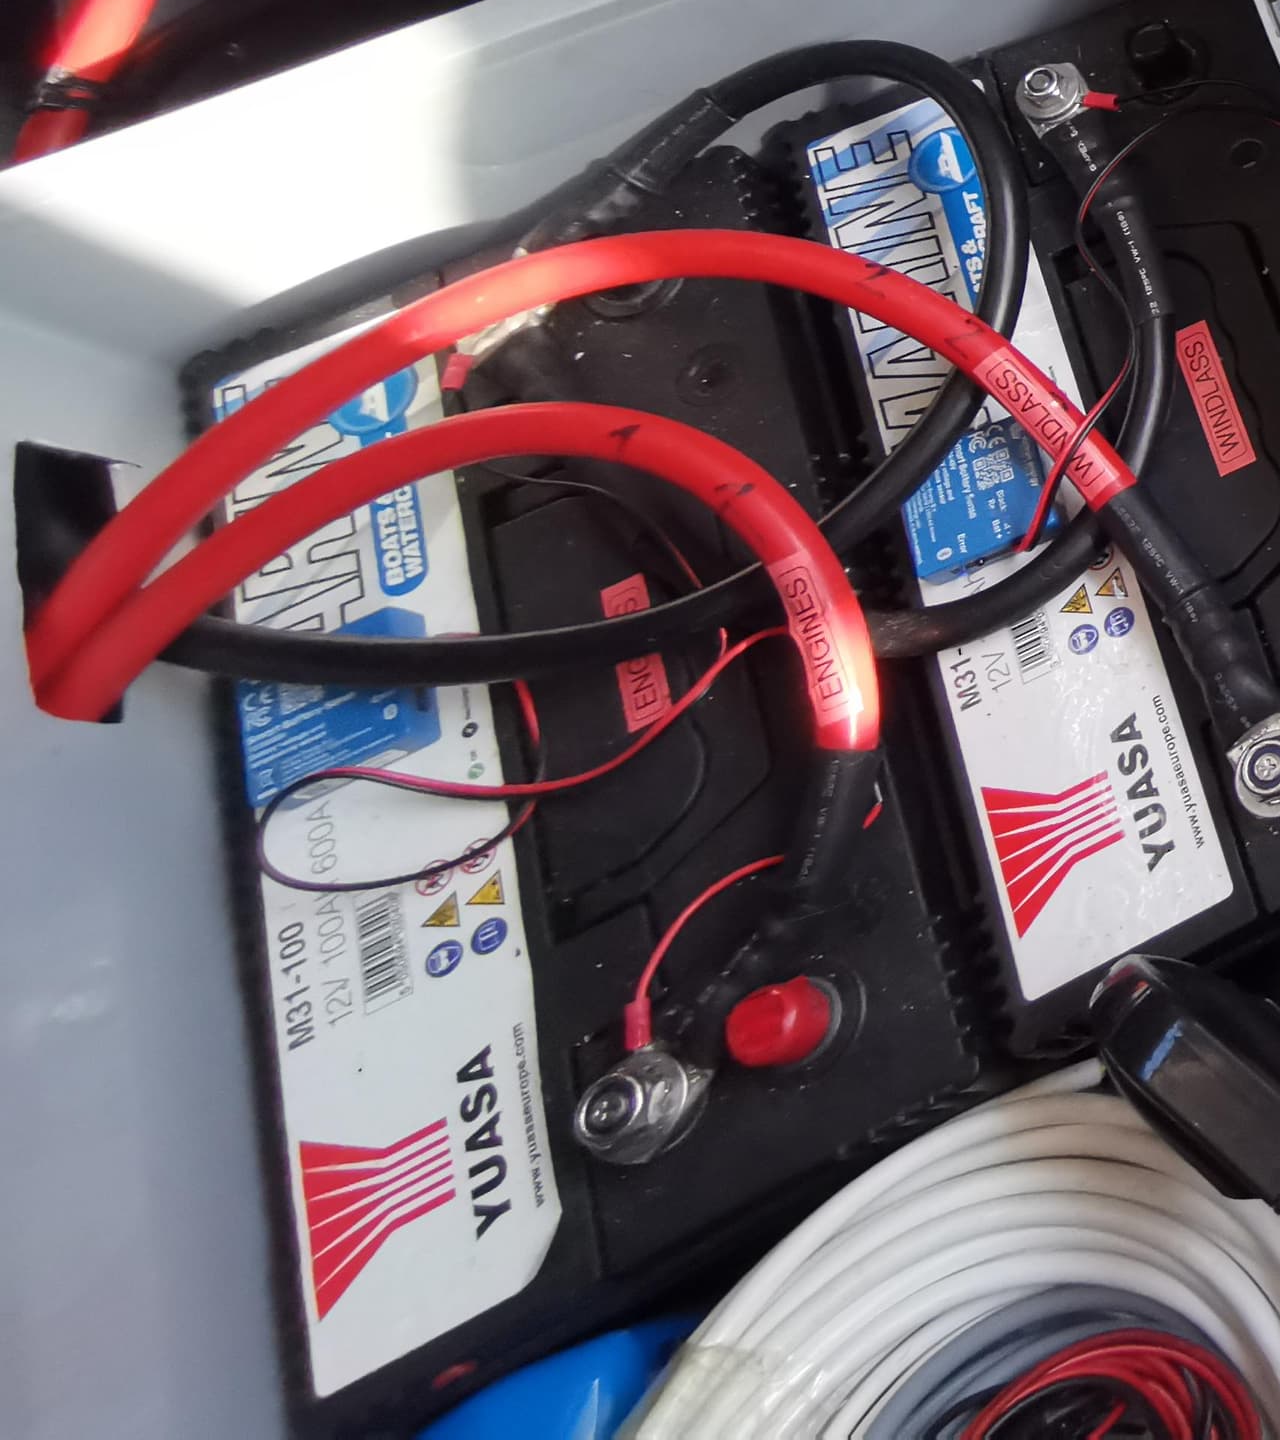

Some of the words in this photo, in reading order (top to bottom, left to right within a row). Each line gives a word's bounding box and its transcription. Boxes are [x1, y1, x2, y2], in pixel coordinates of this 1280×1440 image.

[996, 369, 1094, 479] WNDLASS
[1183, 337, 1248, 458] WINDLASS
[379, 509, 406, 587] BOATS
[785, 576, 844, 700] ENGINES
[982, 652, 1012, 692] 12V
[1109, 712, 1175, 872] YUASA
[1152, 694, 1204, 850] www.yuasaeurope.com
[303, 802, 338, 884] 600A
[281, 922, 316, 1052] M31-100
[325, 980, 357, 1028] 12V
[456, 1044, 511, 1240] YUASA
[511, 1021, 546, 1209] www.yuasaeurope.com
